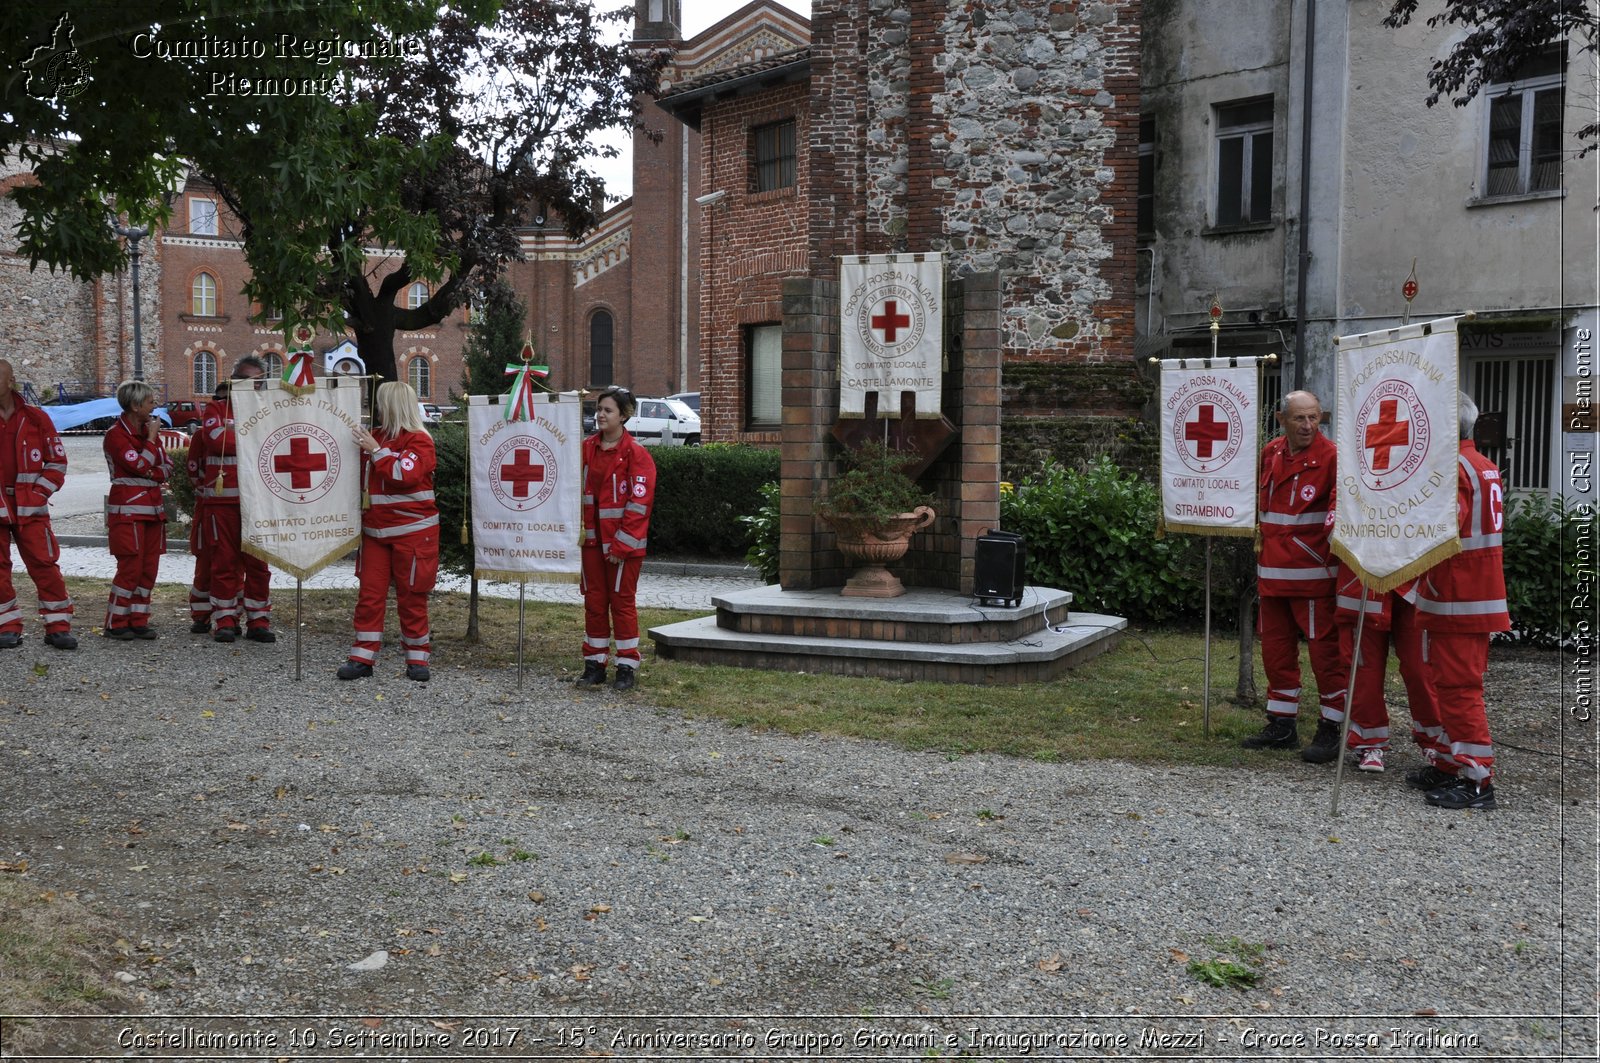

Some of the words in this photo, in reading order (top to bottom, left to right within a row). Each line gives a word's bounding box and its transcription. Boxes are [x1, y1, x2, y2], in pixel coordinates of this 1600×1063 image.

[845, 283, 868, 317] CROCE
[868, 271, 902, 287] ROSSA
[905, 273, 938, 315] ITALIANA
[869, 294, 878, 303] DI
[880, 287, 912, 300] GINEVRA
[911, 300, 920, 310] 22
[860, 305, 884, 354] CONVENZIONE
[1460, 332, 1504, 348] AVIS
[855, 361, 891, 370] COMITATO
[894, 361, 927, 369] LOCALE
[1350, 361, 1376, 398] CROCE
[1374, 349, 1406, 371] ROSSA
[848, 378, 934, 388] CASTELLAMONTE
[1376, 383, 1410, 398] GINEVRA
[1166, 383, 1189, 410] CROCE
[1190, 375, 1216, 389] ROSSA
[1219, 378, 1251, 410] ITALIANA
[1193, 392, 1223, 404] GINEVRA
[1186, 398, 1194, 407] DI
[1223, 400, 1232, 411] 22
[239, 406, 271, 436] CROCE
[273, 397, 312, 410] ROSSA
[282, 426, 318, 436] GINEVRA
[480, 420, 504, 446] CROCE
[536, 416, 567, 446] ITALIANA
[1175, 406, 1189, 461] CONVENZIONE
[1230, 411, 1240, 446] AGOSTO
[1412, 403, 1427, 451] AGOSTO
[274, 432, 283, 441] DI
[319, 432, 330, 442] 22
[510, 438, 540, 449] GINEVRA
[503, 443, 511, 451] DI
[539, 446, 549, 455] 22
[1221, 447, 1235, 462] 1864
[260, 438, 281, 493] CONVENZIONE
[327, 441, 339, 475] AGOSTO
[1402, 453, 1420, 474] 1864
[491, 450, 505, 500] CONVENZIONE
[546, 454, 555, 486] AGOSTO
[322, 476, 335, 491] 1864
[1173, 477, 1205, 489] COMITATO
[1207, 479, 1240, 490] LOCALE
[538, 488, 550, 500] 1864
[1197, 491, 1205, 501] DI
[1380, 485, 1434, 520] LOCALE
[1429, 471, 1445, 488] DI
[1175, 504, 1234, 518] STRAMBINO
[254, 517, 306, 529] COMITATO
[310, 513, 348, 525] LOCALE
[483, 521, 523, 531] COMITATO
[528, 523, 565, 532] LOCALE
[249, 532, 297, 544] SETTIMO
[303, 527, 355, 541] TORINESE
[483, 547, 505, 557] PONT
[509, 549, 566, 559] CANAVESE
